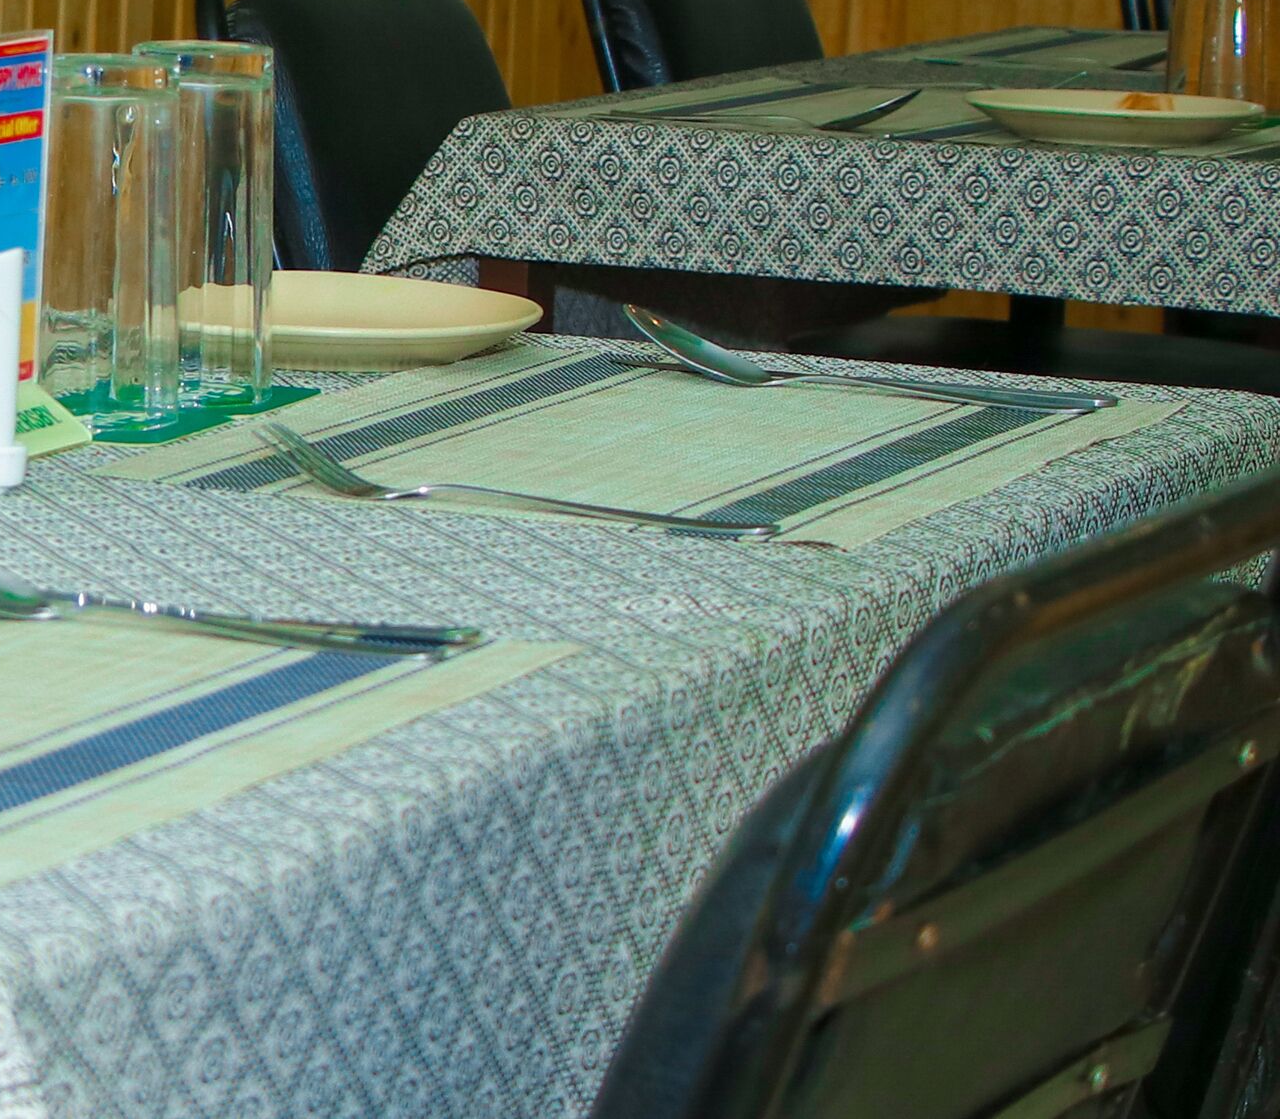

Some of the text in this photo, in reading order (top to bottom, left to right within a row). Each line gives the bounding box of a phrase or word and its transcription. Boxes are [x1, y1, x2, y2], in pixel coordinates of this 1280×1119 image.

[16, 61, 42, 90] HOME
[15, 116, 39, 137] Offer
[15, 405, 62, 433] ERSBY
